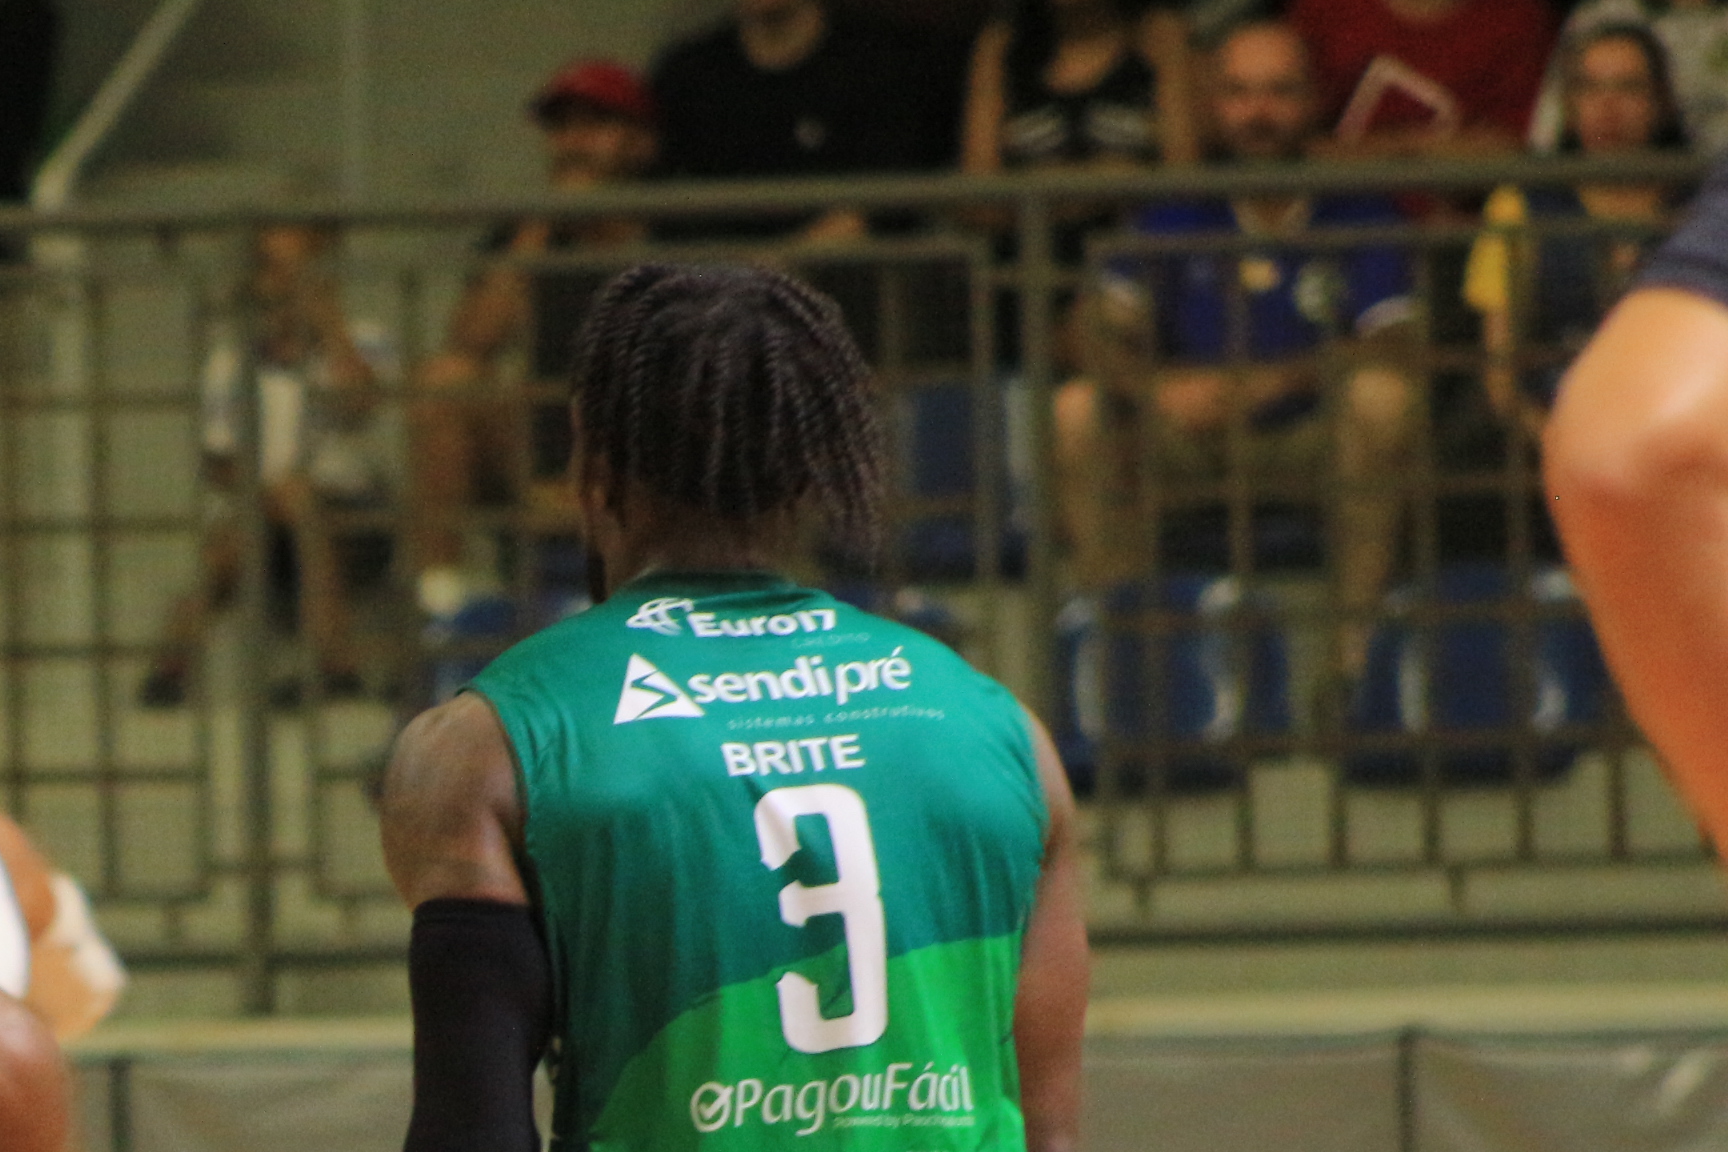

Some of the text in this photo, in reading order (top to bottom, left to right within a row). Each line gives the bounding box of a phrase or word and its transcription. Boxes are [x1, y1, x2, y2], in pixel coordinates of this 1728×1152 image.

[686, 608, 837, 638] Euro17
[721, 734, 866, 777] BRITE
[753, 784, 888, 1055] 3
